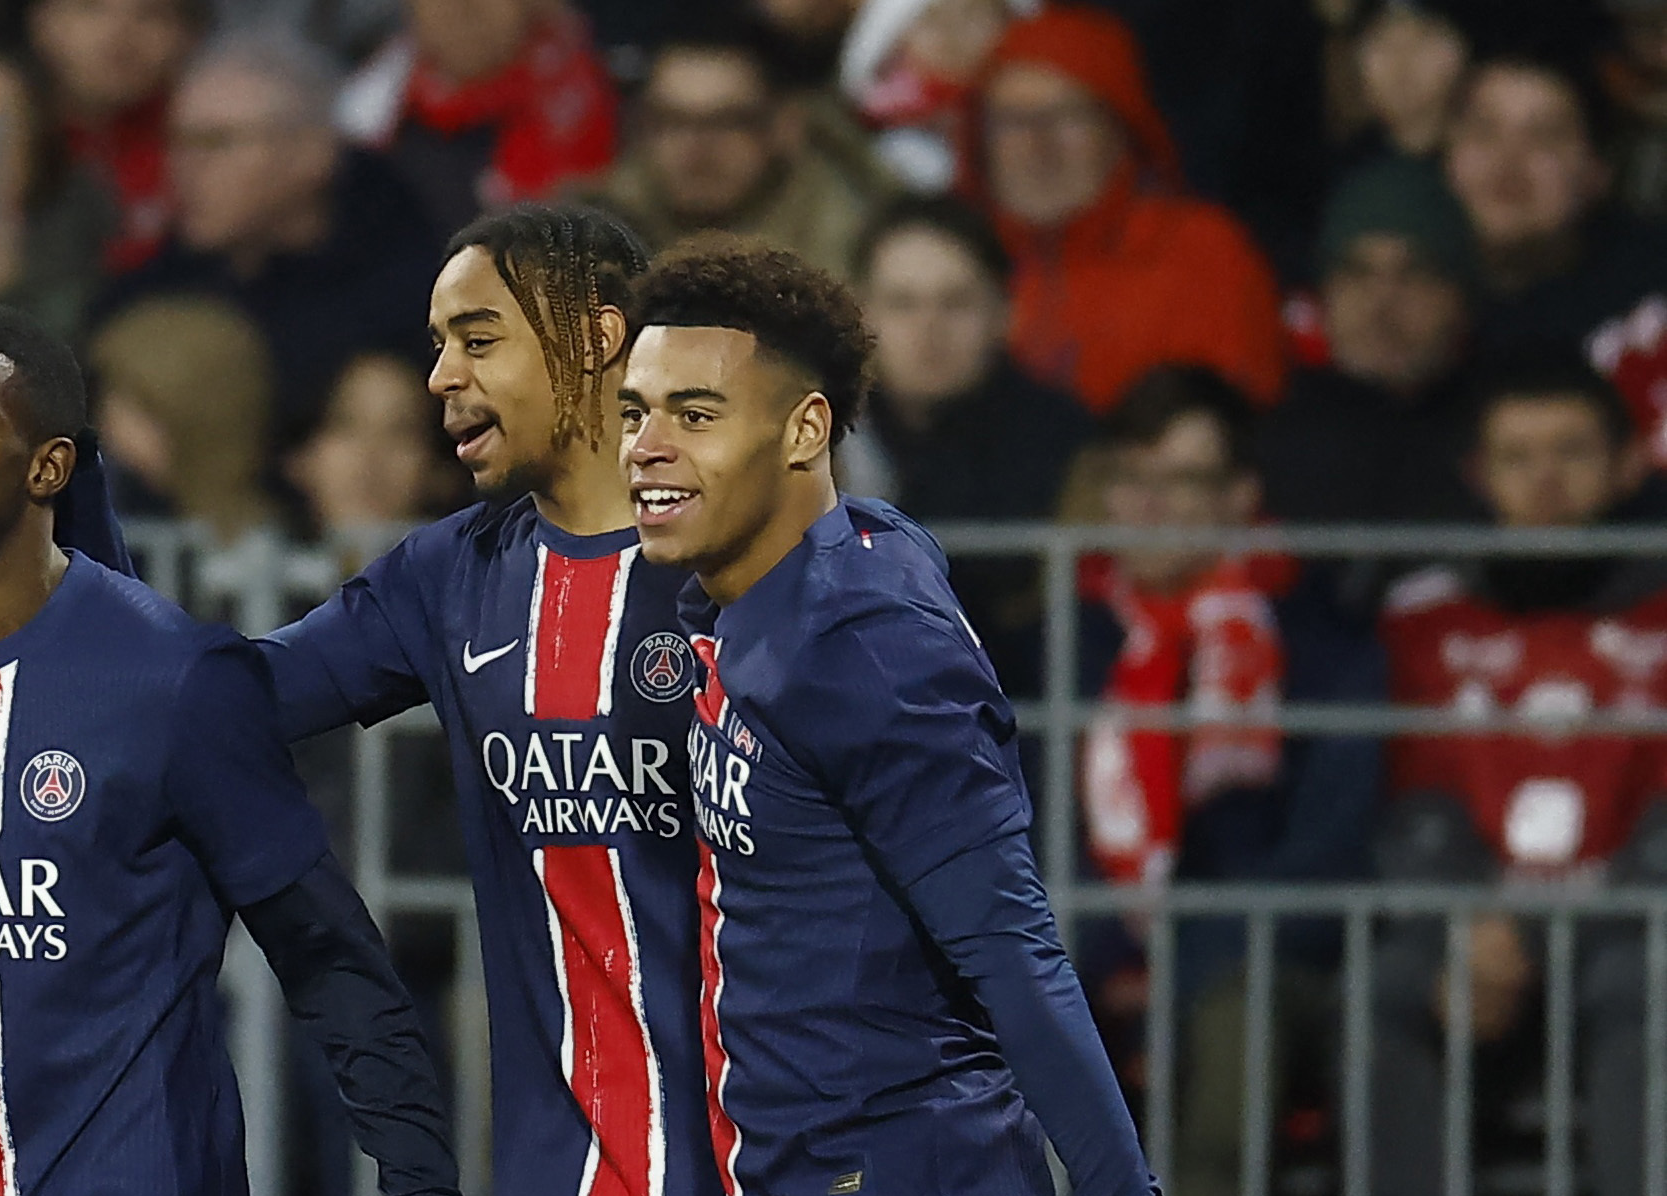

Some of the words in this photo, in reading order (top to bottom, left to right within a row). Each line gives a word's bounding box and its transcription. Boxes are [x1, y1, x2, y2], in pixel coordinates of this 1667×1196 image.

[645, 636, 686, 655] PARIS
[33, 754, 76, 773] PARIS
[483, 731, 677, 805] QATAR
[522, 797, 681, 838] AIRWAYS
